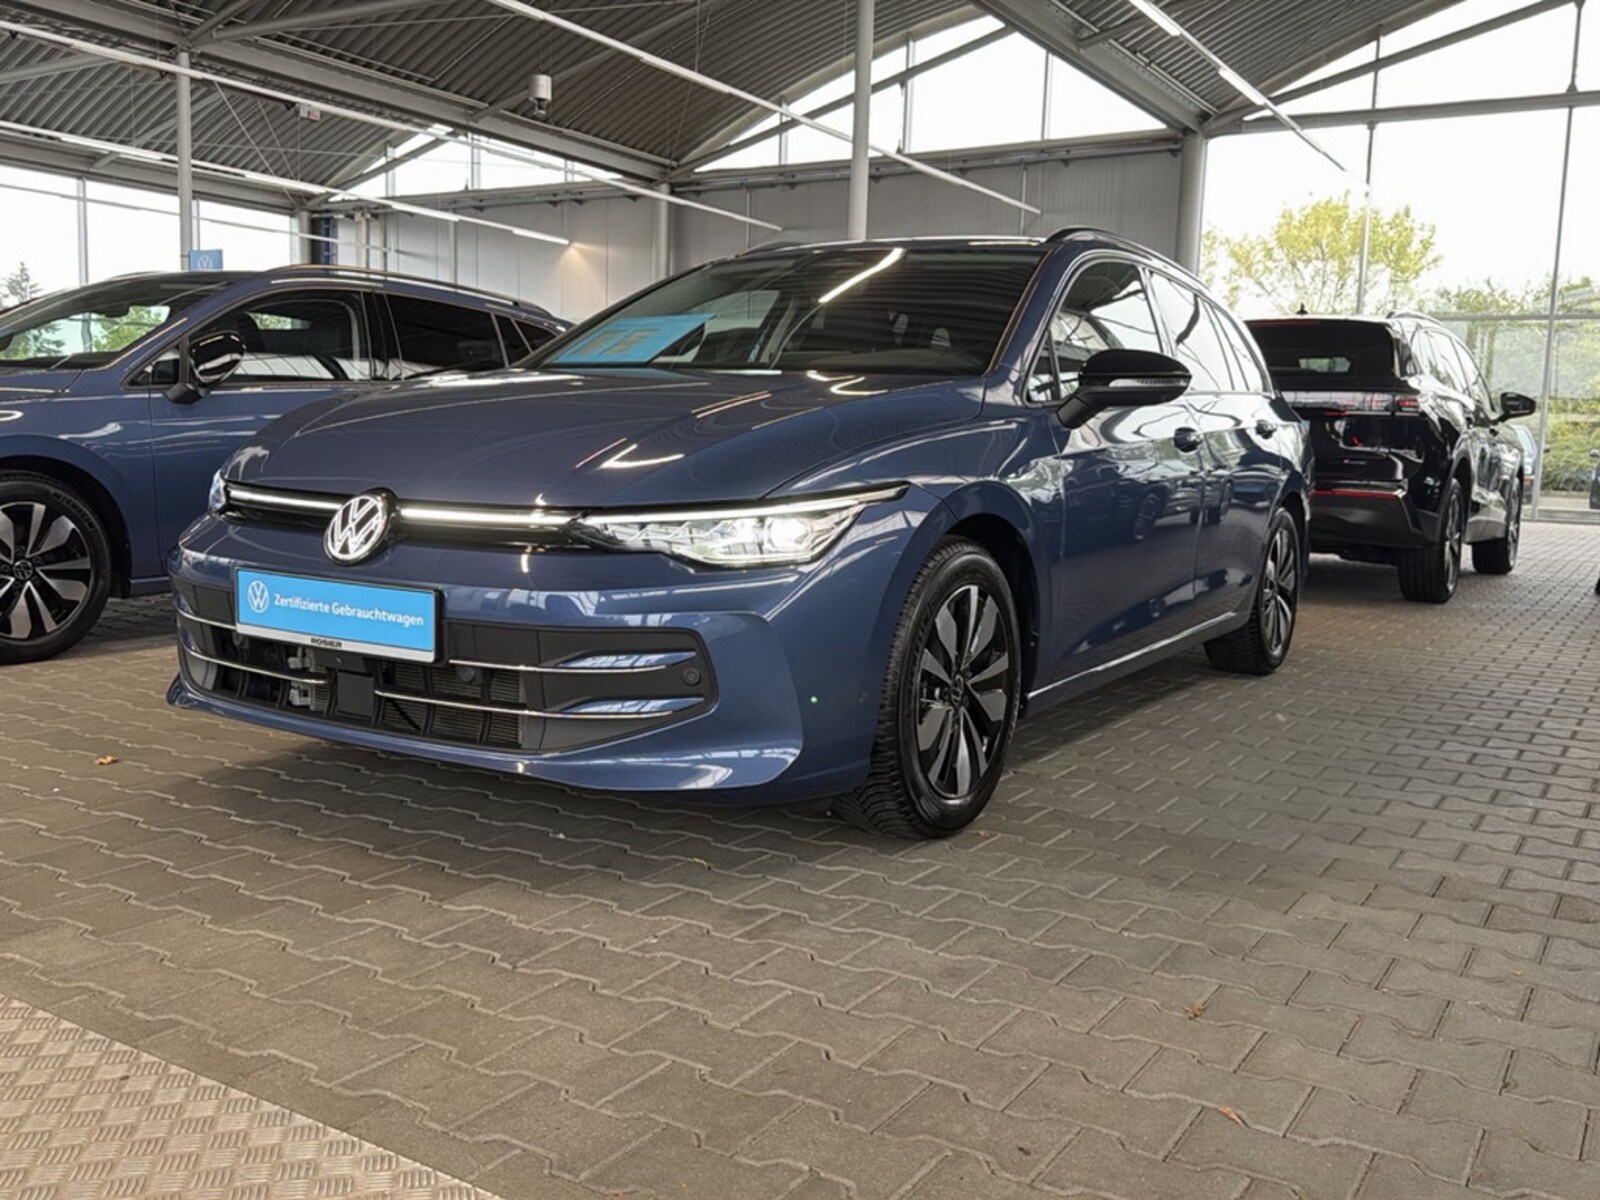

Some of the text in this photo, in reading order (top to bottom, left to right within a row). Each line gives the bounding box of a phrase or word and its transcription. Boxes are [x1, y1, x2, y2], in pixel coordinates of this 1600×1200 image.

[326, 495, 385, 561] VW
[248, 581, 269, 613] VW
[274, 593, 424, 627] Zertifizierte Gebrauchtwagen
